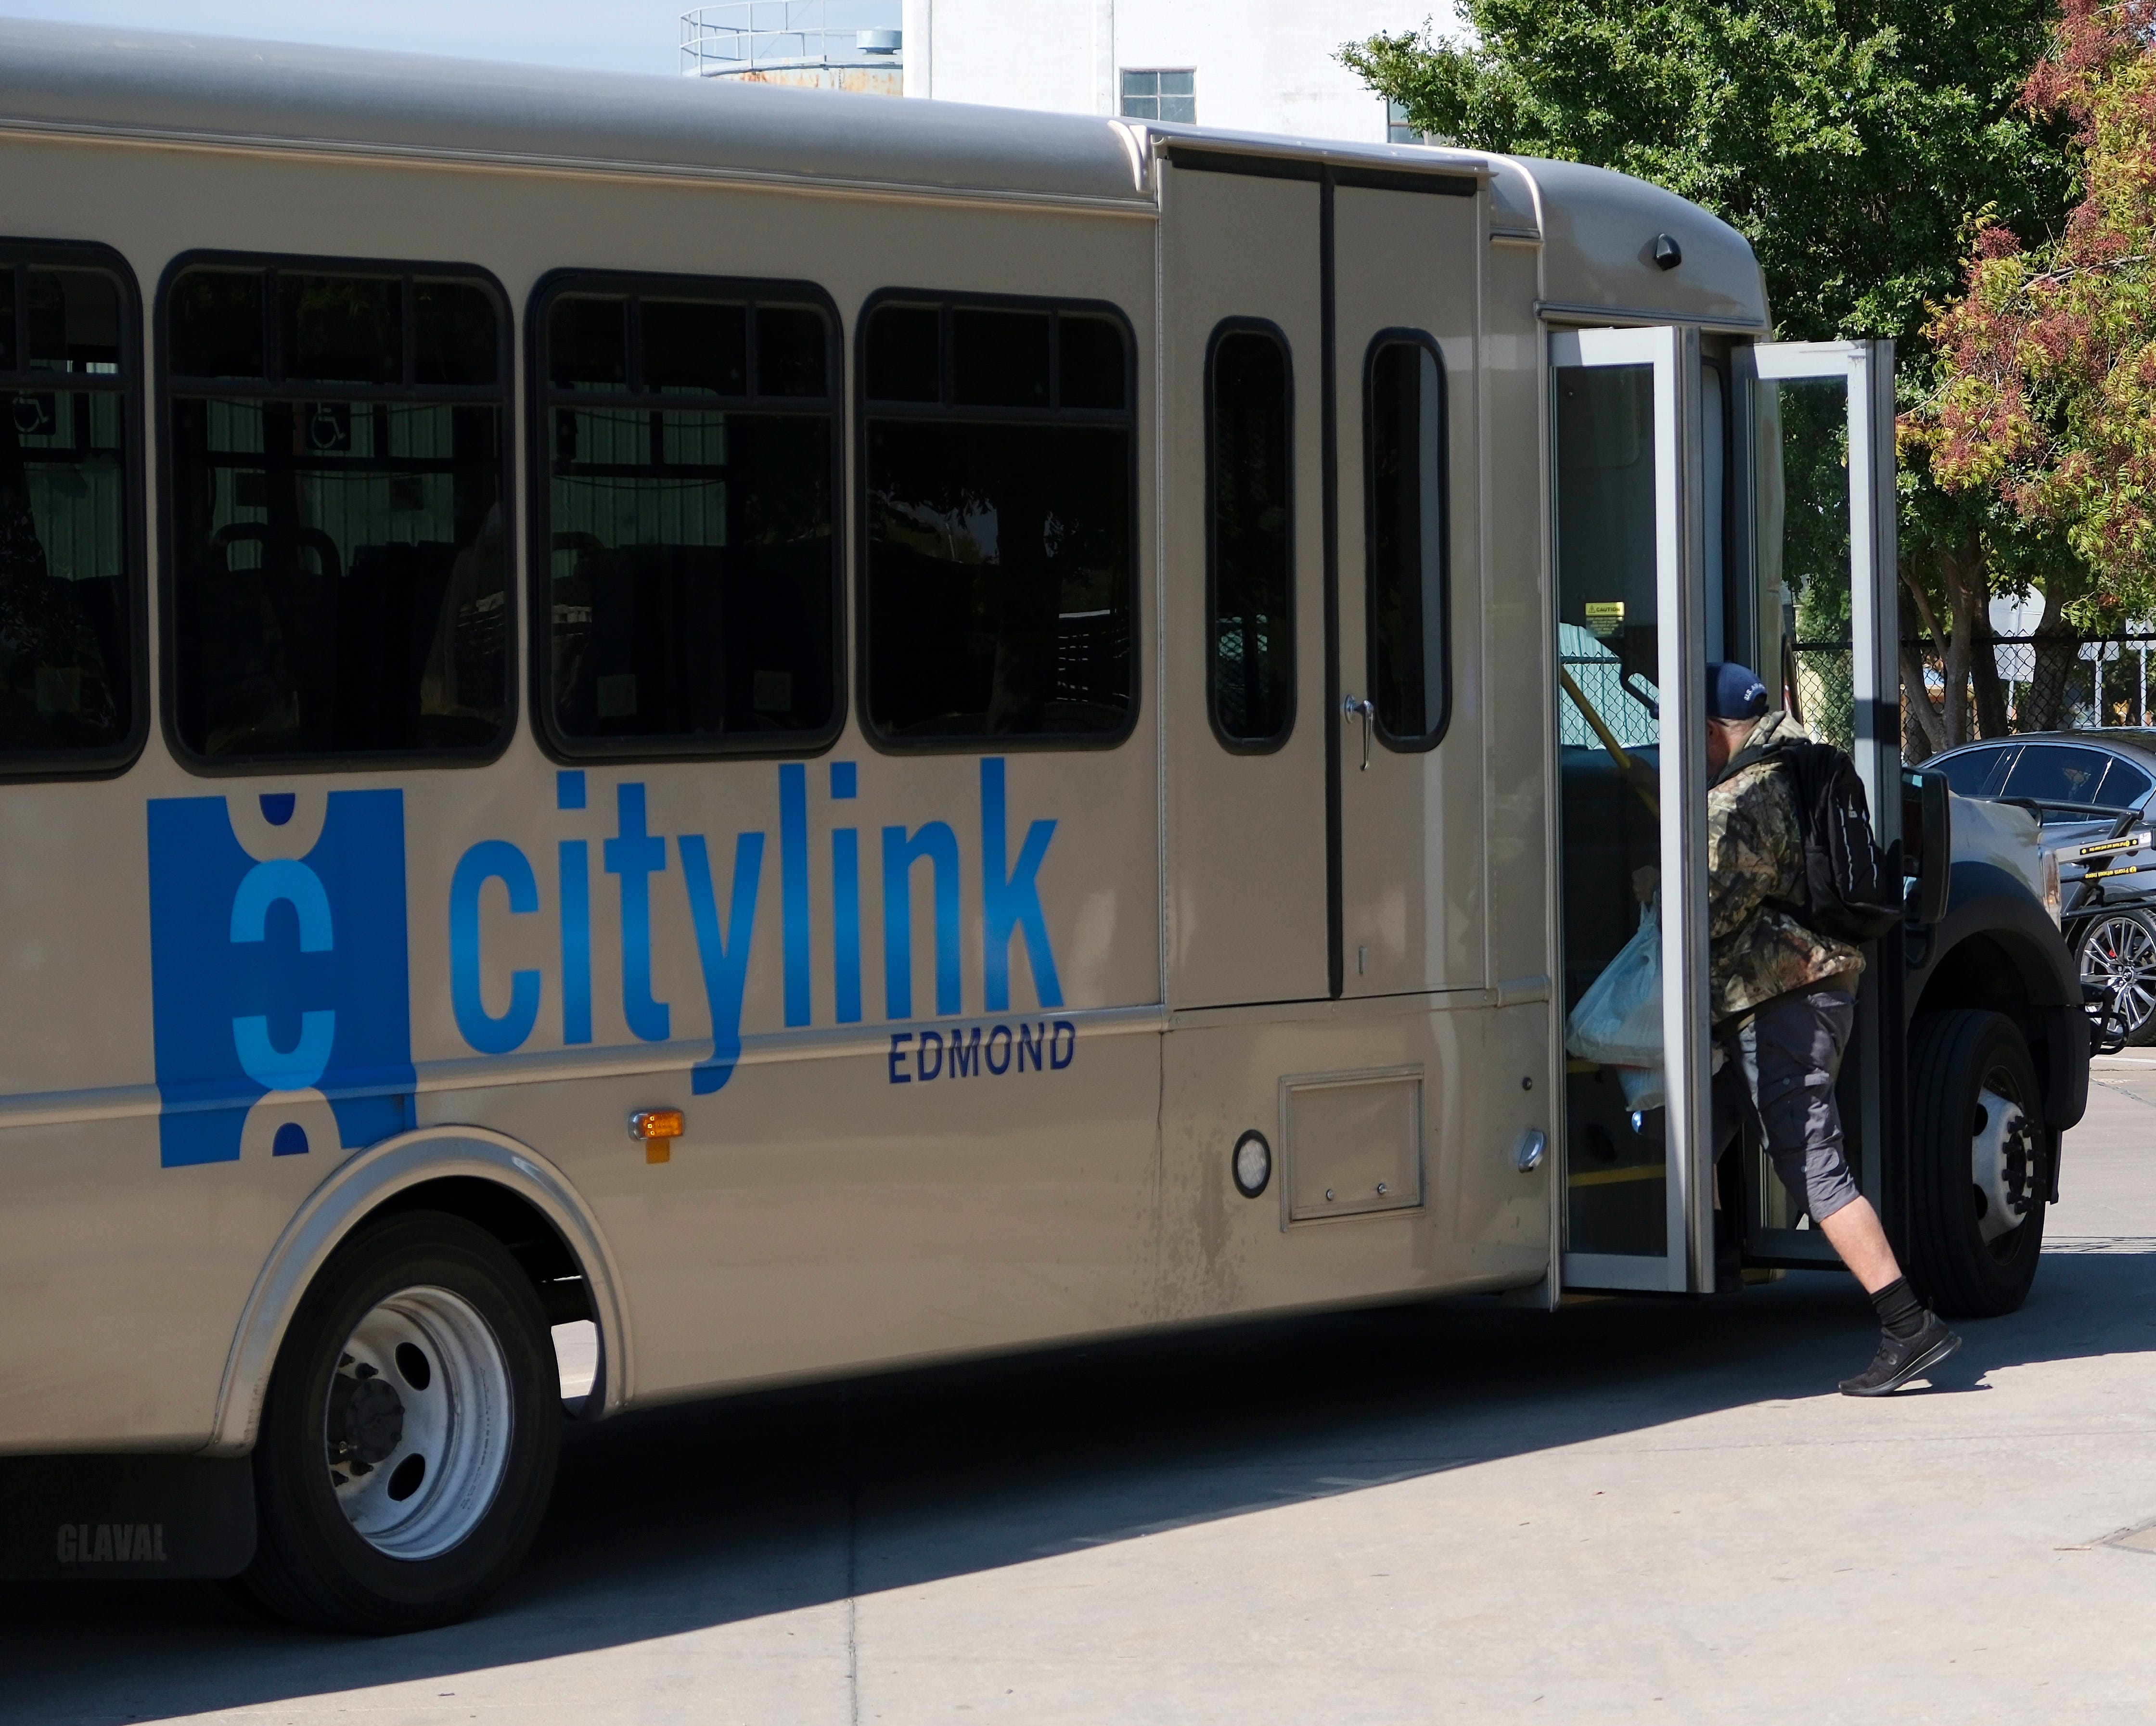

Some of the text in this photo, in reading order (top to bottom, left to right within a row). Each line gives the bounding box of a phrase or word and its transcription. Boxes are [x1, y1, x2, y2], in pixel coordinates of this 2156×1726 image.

[448, 757, 1064, 1096] citylink
[888, 1020, 1076, 1084] EDMOND
[56, 1523, 167, 1563] GLAVAL
